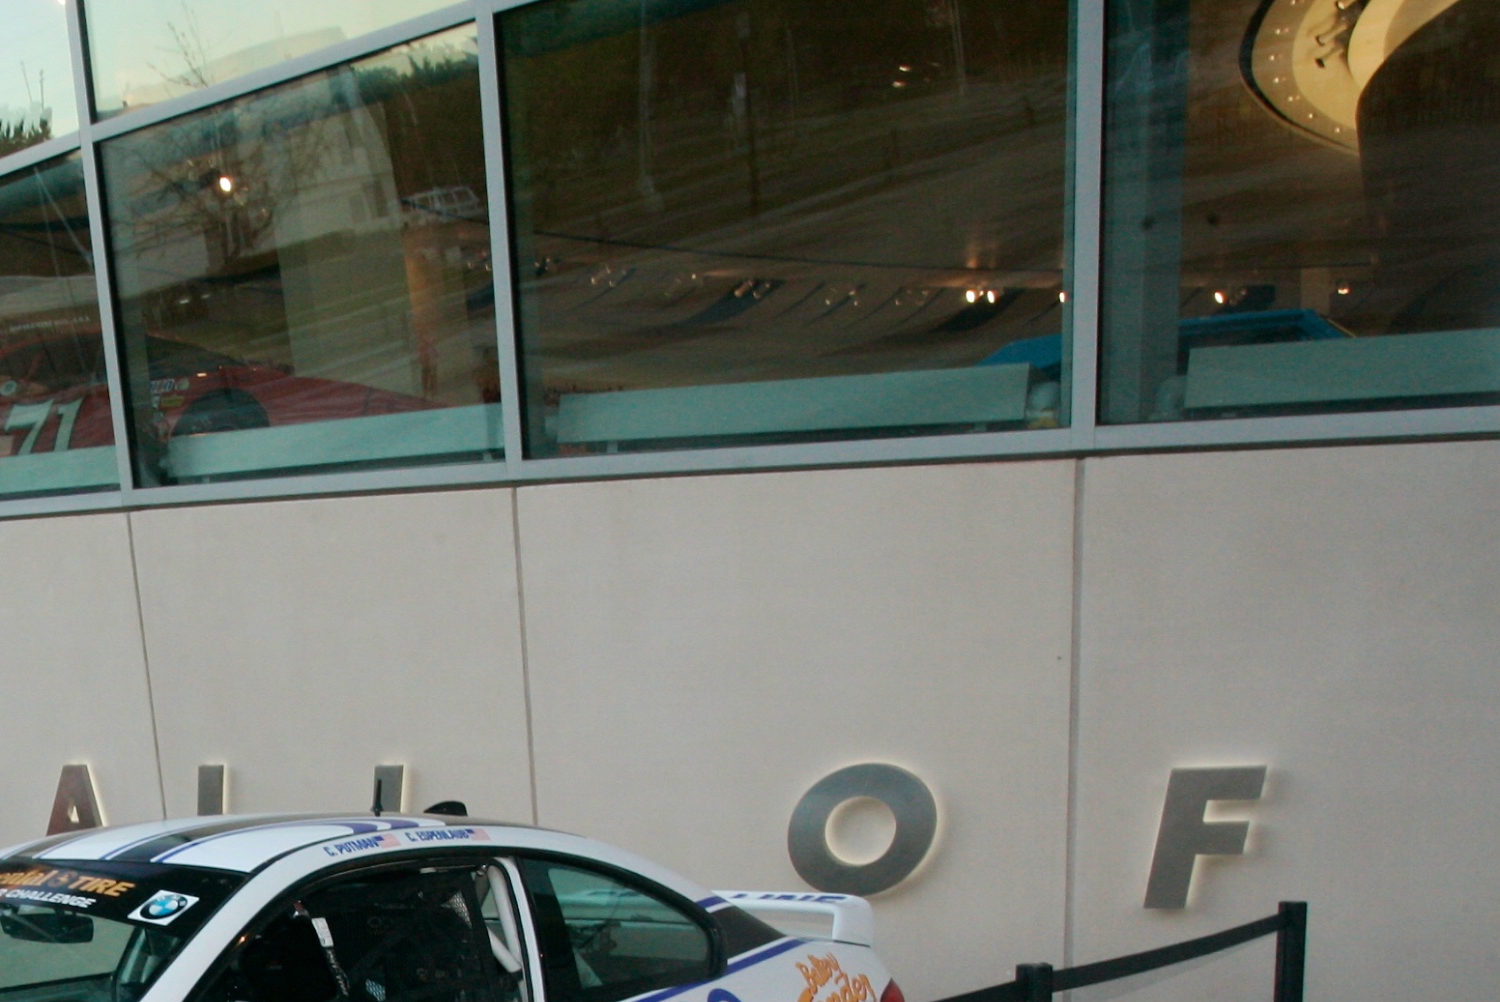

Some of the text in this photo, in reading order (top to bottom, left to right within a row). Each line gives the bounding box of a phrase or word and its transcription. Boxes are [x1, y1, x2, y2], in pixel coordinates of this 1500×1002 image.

[4, 396, 85, 456] 71
[335, 837, 379, 854] PUTMAN
[787, 762, 1268, 909] OF
[68, 875, 135, 896] TIRE
[5, 889, 97, 908] CHALLENGE
